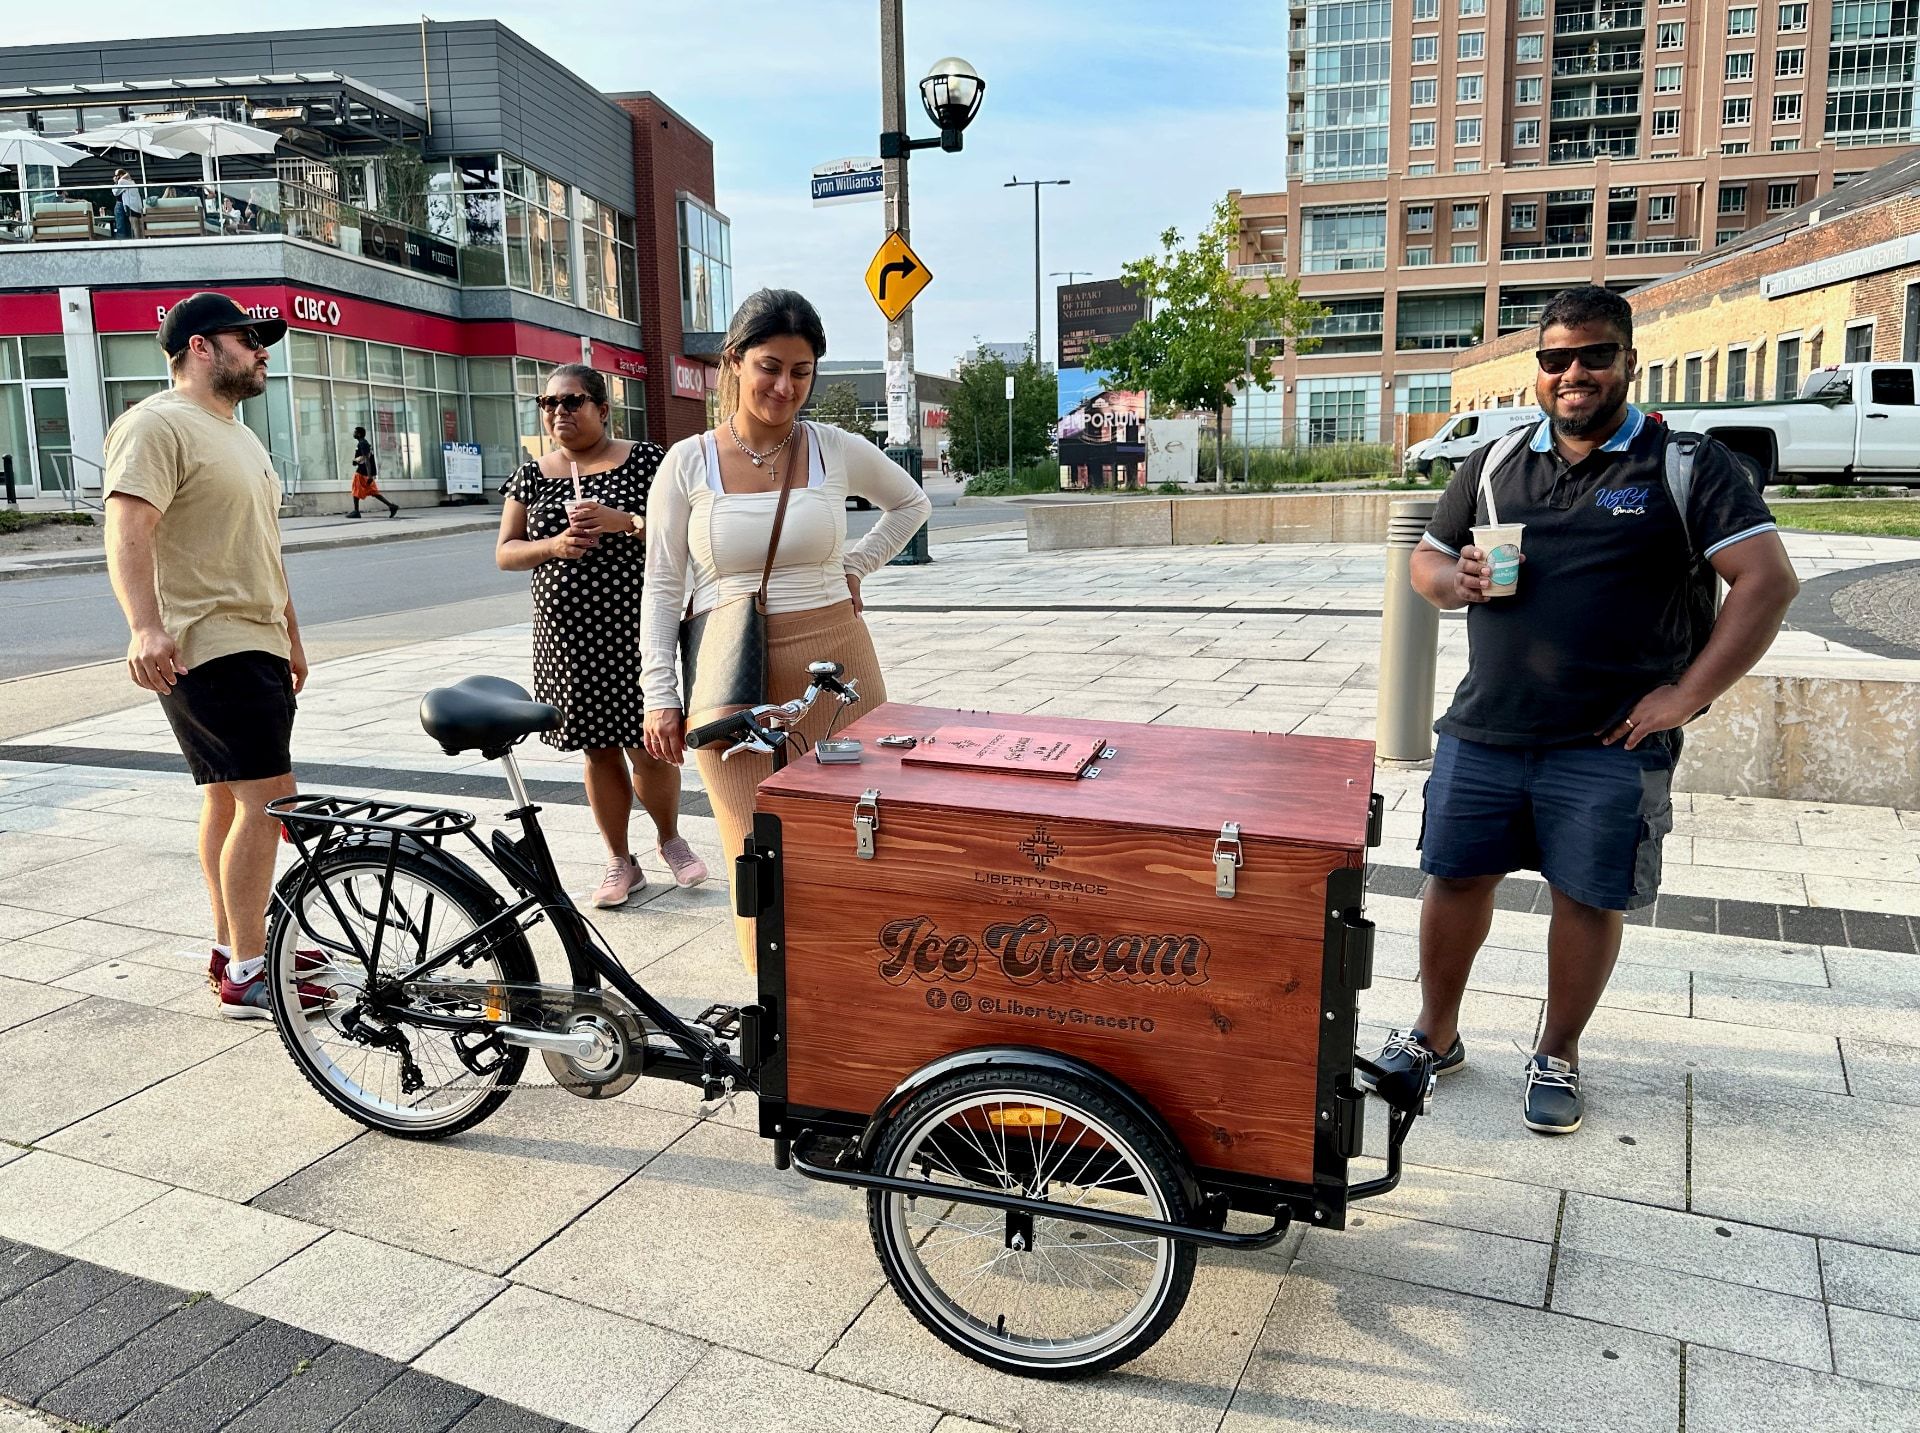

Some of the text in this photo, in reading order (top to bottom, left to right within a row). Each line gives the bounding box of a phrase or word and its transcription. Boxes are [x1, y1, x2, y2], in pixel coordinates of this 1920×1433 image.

[813, 175, 883, 196] Lynn Williams St
[404, 241, 454, 267] PASTA PIZZETTE
[1788, 268, 1817, 287] TOWERS
[1817, 255, 1871, 281] PRESENTATION
[1872, 245, 1906, 266] CENTRE
[1062, 300, 1092, 310] OF THE
[1063, 290, 1102, 302] BE A PART
[246, 304, 279, 319] ntre
[294, 295, 328, 323] CIBC
[1063, 303, 1137, 319] NEIGHBOURHOOD
[677, 366, 695, 390] CIBC
[1062, 411, 1140, 430] EMPORIUM
[452, 441, 478, 455] Notice
[1595, 487, 1649, 509] USPA
[1612, 506, 1635, 516] Denim
[974, 872, 1108, 896] LIBERTY GRACE
[878, 914, 1211, 986] Ice Cream
[978, 997, 1155, 1033] @LibertyGraceTO
